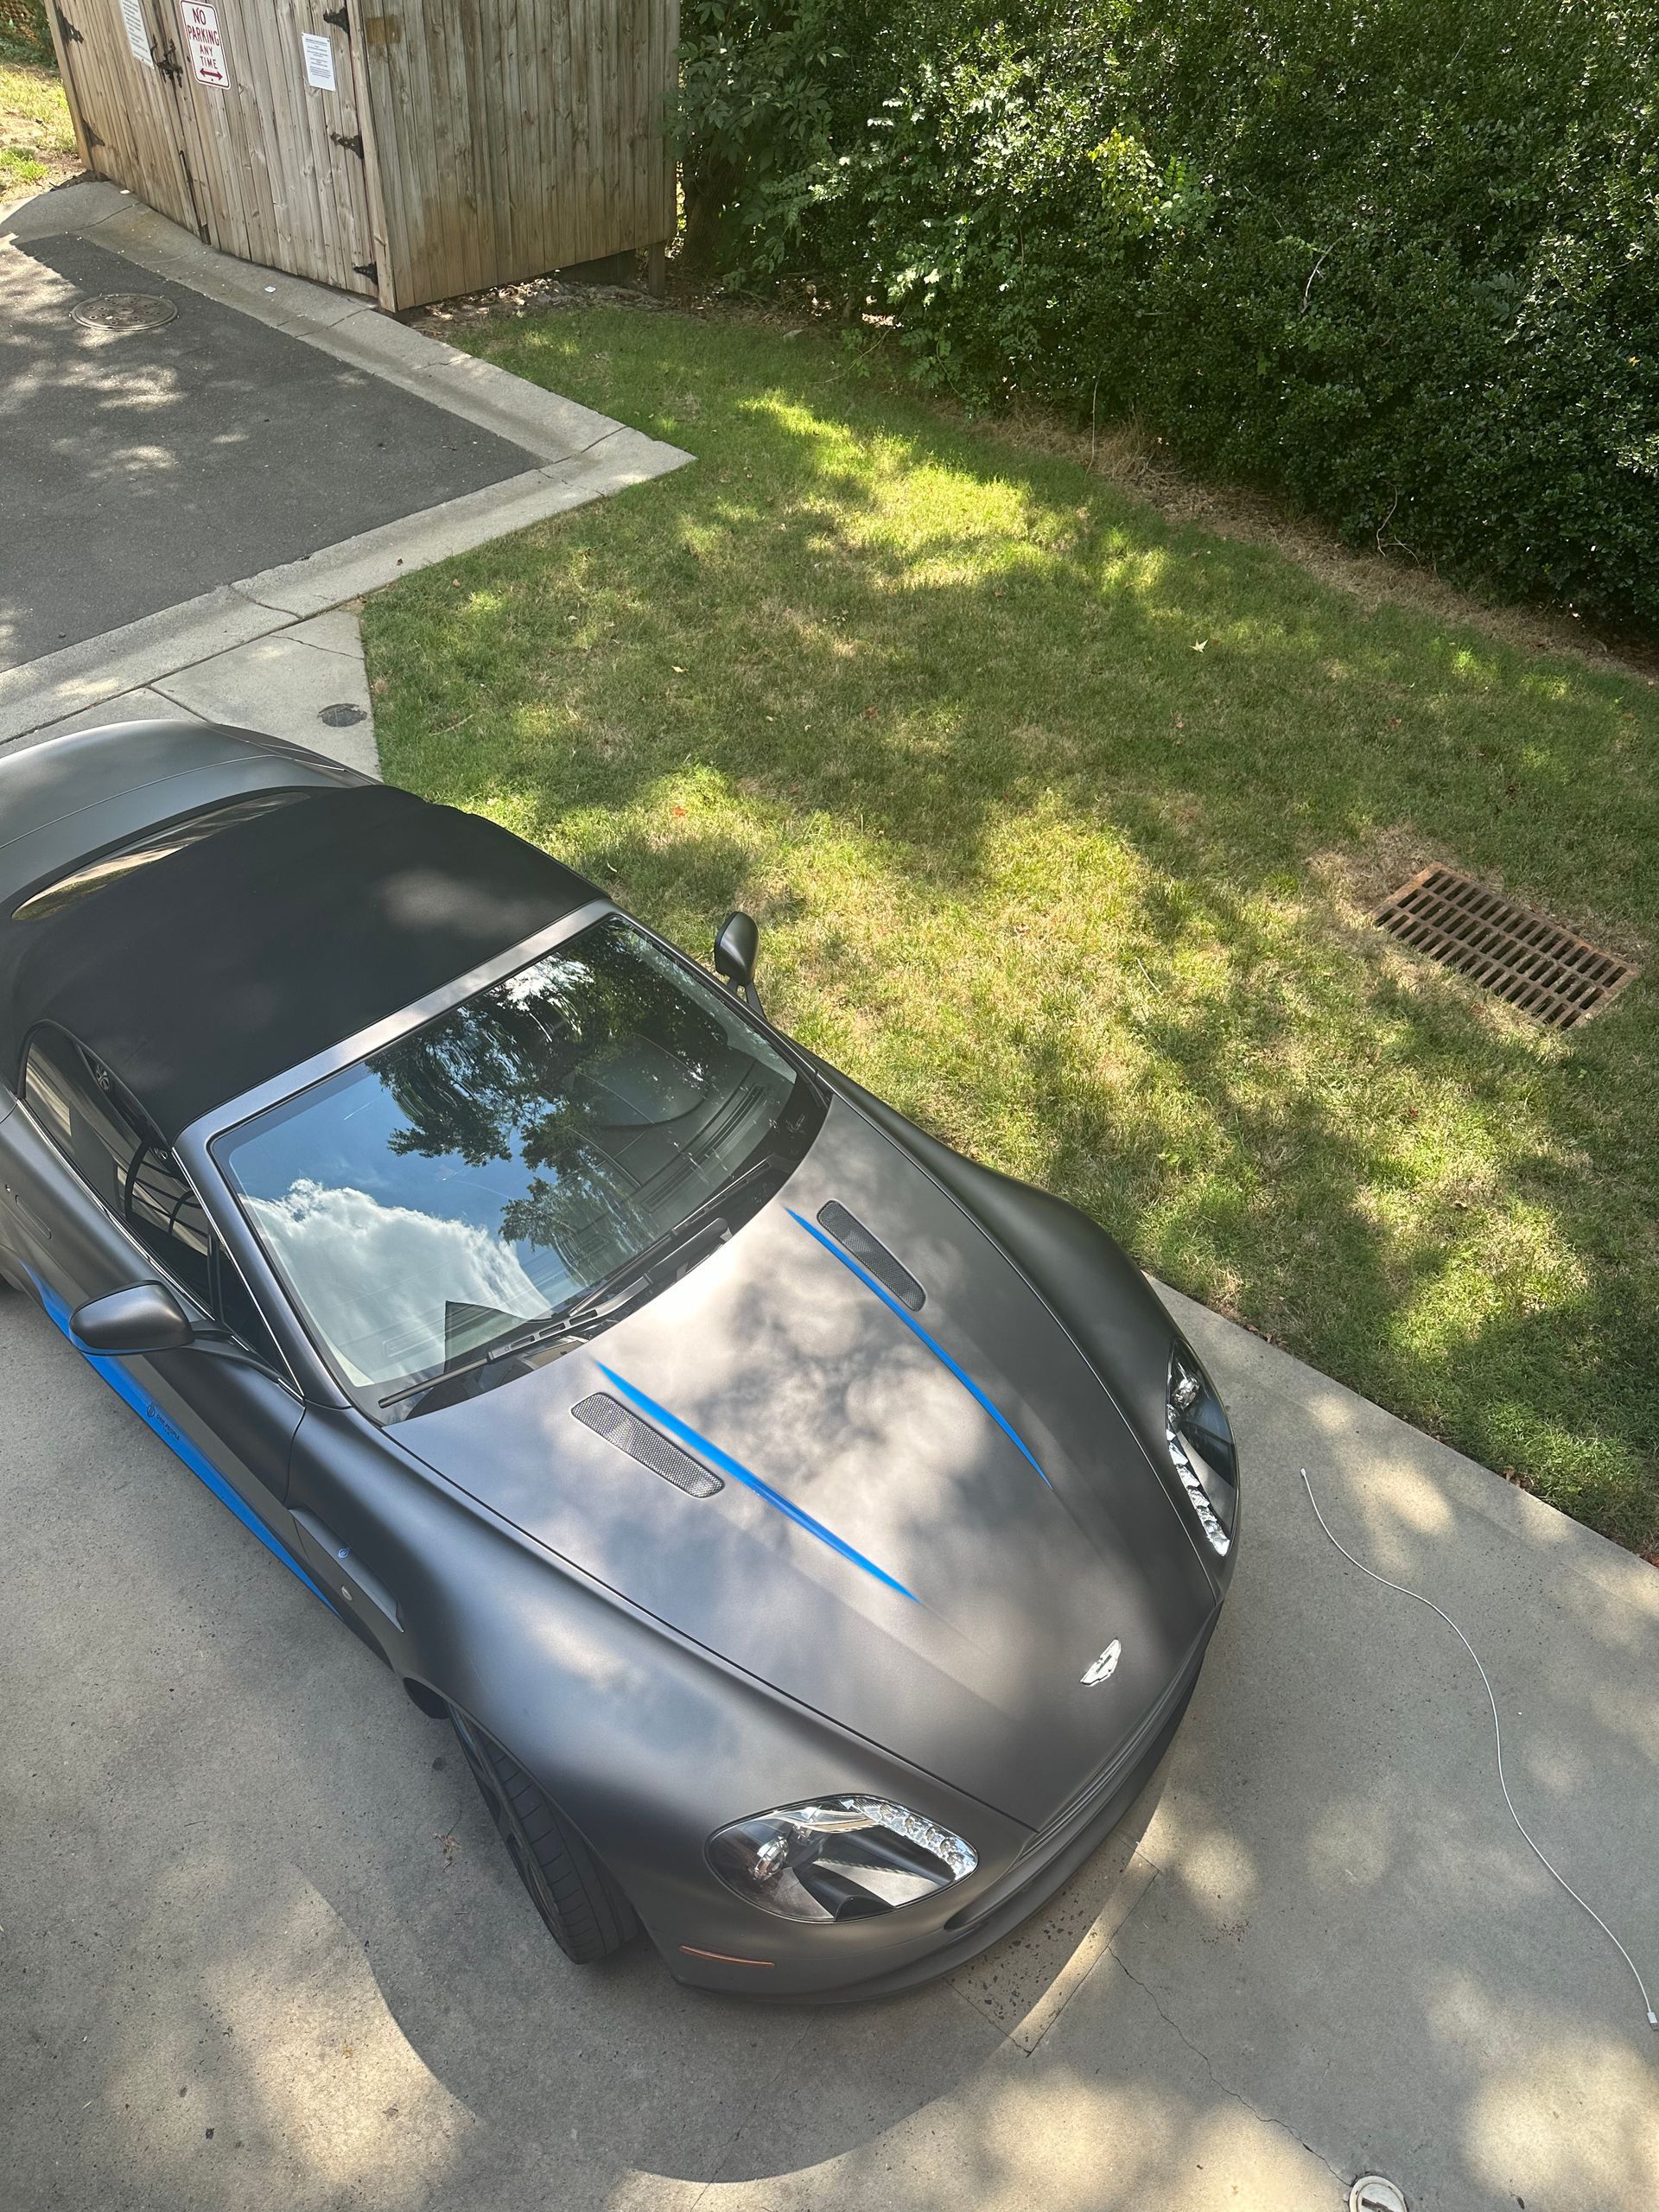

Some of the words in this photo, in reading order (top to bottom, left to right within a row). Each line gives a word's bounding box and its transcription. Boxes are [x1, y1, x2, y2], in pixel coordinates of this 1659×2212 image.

[192, 7, 207, 25] NO
[187, 25, 220, 46] PARKING
[200, 44, 213, 56] ANY
[200, 56, 219, 69] TIME
